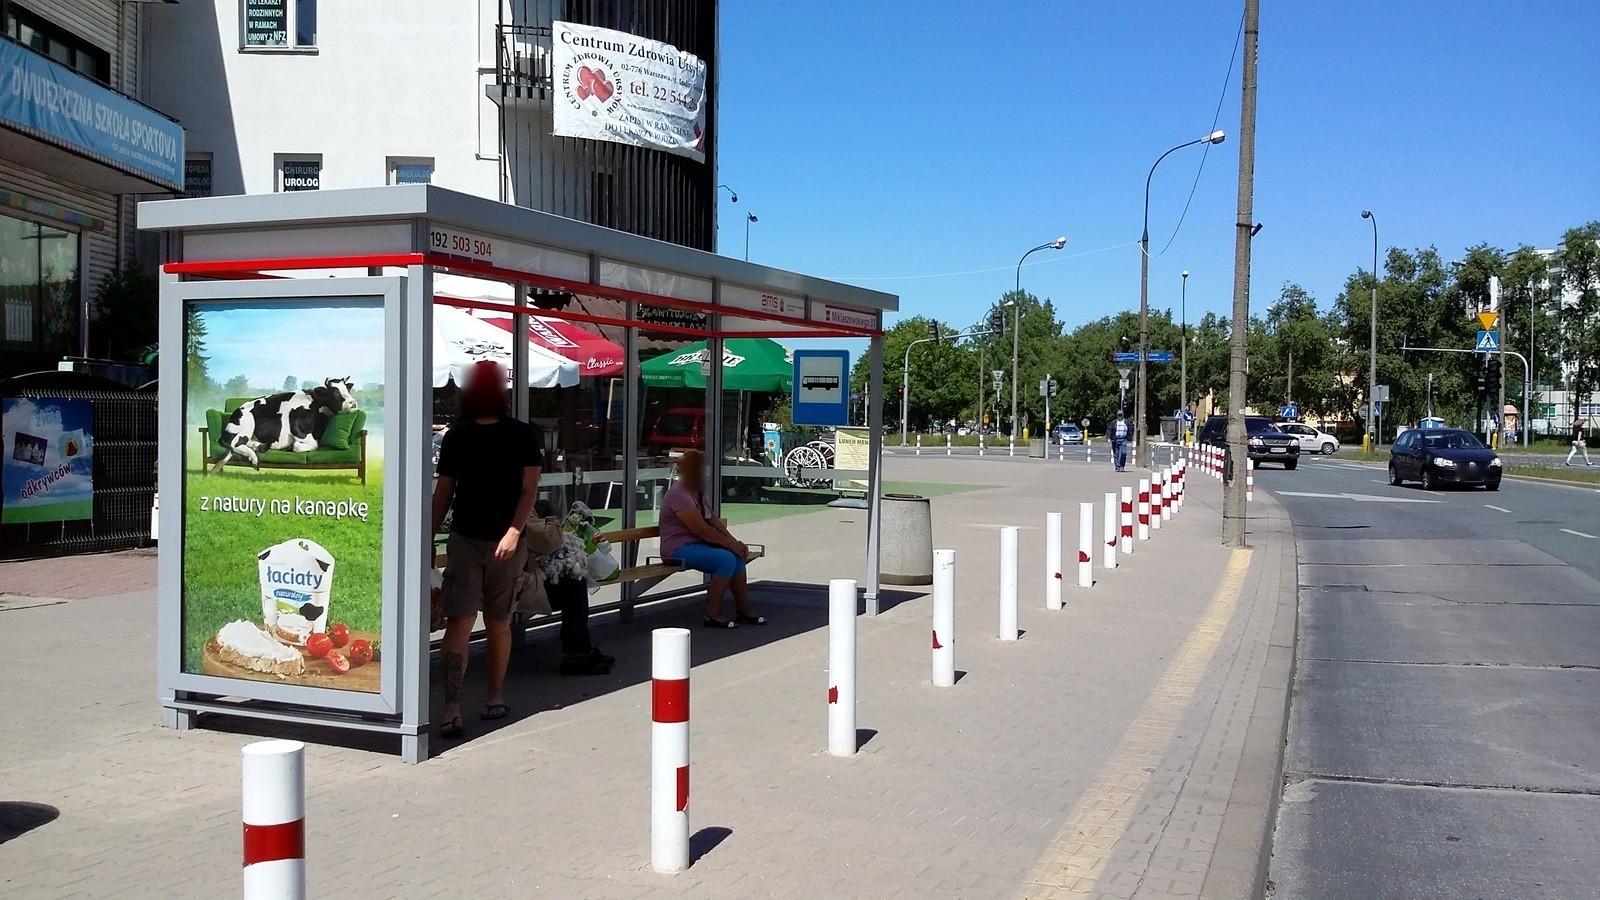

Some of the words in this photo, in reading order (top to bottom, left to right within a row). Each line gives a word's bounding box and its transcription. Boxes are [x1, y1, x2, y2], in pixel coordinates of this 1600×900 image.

[249, 9, 283, 17] RODZINNYCH
[248, 33, 268, 41] UMOWY
[274, 30, 286, 41] NFZ
[561, 31, 624, 53] Centrum
[628, 42, 675, 66] Zdrowia
[621, 64, 642, 74] 02-776
[563, 63, 581, 110] CENTRUM
[573, 52, 613, 70] ZDROWIA
[630, 81, 649, 98] tel.
[653, 86, 667, 101] 22
[95, 102, 129, 143] SZKOŁA
[131, 119, 177, 163] SPORTOWA
[285, 166, 319, 175] CHIRURG
[285, 178, 319, 187] UROLOG
[430, 231, 448, 249] 192
[453, 235, 470, 253] 503
[474, 239, 492, 257] 504
[761, 293, 778, 309] ams
[587, 357, 614, 370] Classic
[21, 463, 71, 499] odkrywców
[200, 496, 209, 511] z
[213, 496, 266, 518] natury
[270, 499, 290, 515] na
[295, 496, 368, 522] kanapkę
[267, 566, 323, 589] łaciaty
